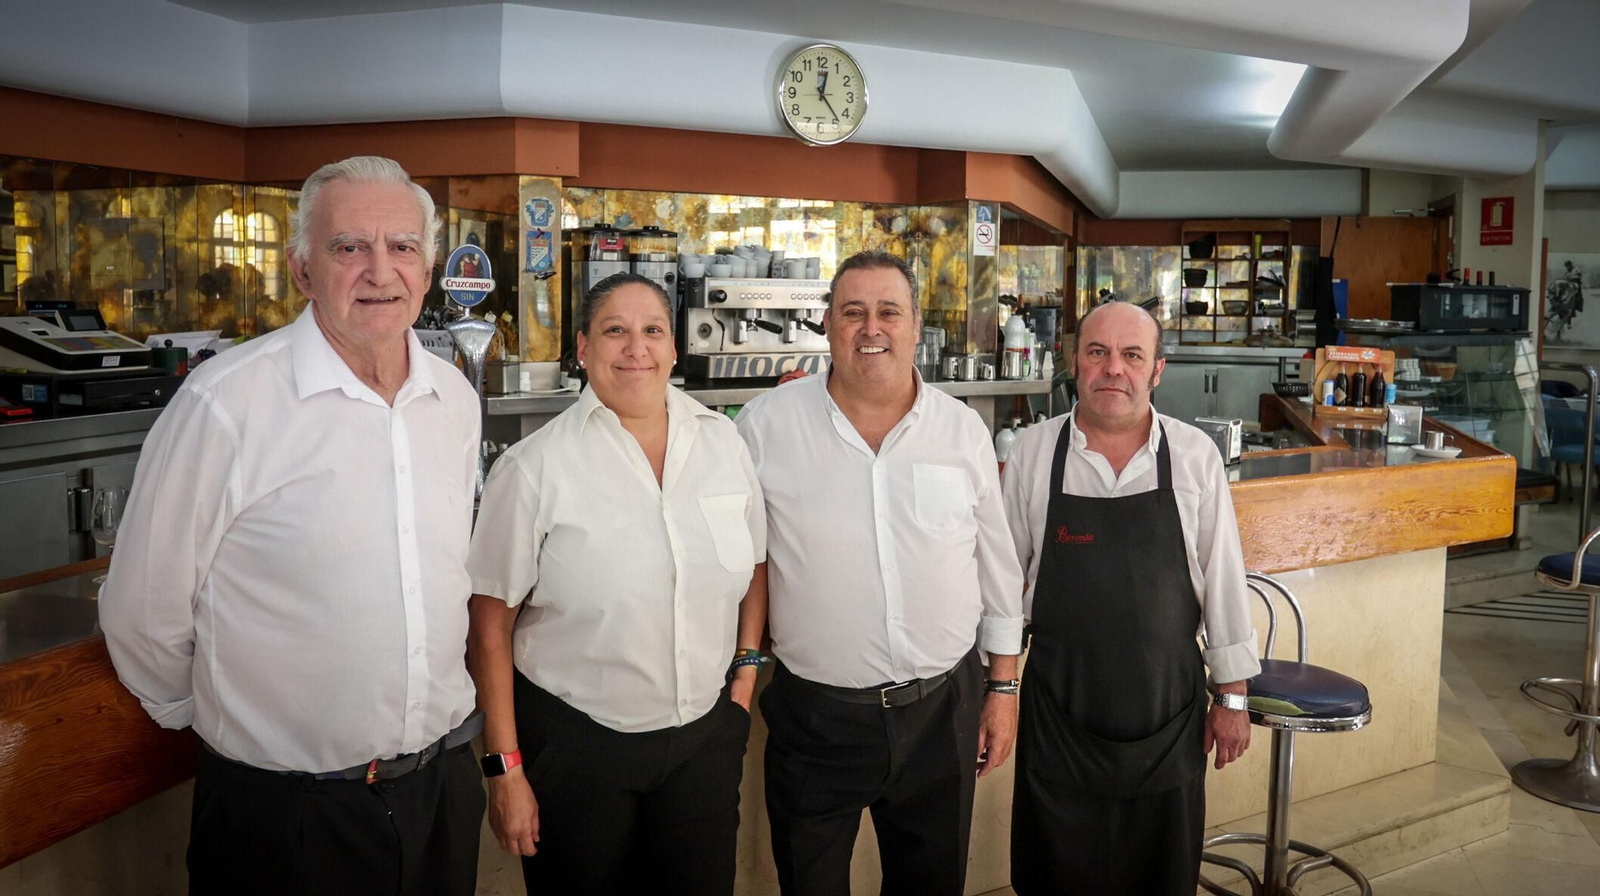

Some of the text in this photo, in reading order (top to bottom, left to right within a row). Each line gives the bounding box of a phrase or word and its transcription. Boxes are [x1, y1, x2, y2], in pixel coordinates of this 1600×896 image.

[802, 59, 811, 71] 11
[816, 56, 828, 69] 12
[835, 62, 839, 74] 1
[791, 70, 803, 83] 10
[843, 75, 851, 87] 2
[788, 86, 797, 98] 9
[846, 91, 854, 103] 3
[791, 104, 800, 116] 8
[841, 108, 850, 119] 4
[803, 116, 812, 126] 7
[832, 119, 839, 130] 5
[817, 122, 824, 134] 6
[445, 279, 491, 289] Cruzcampo
[461, 292, 475, 301] SIN
